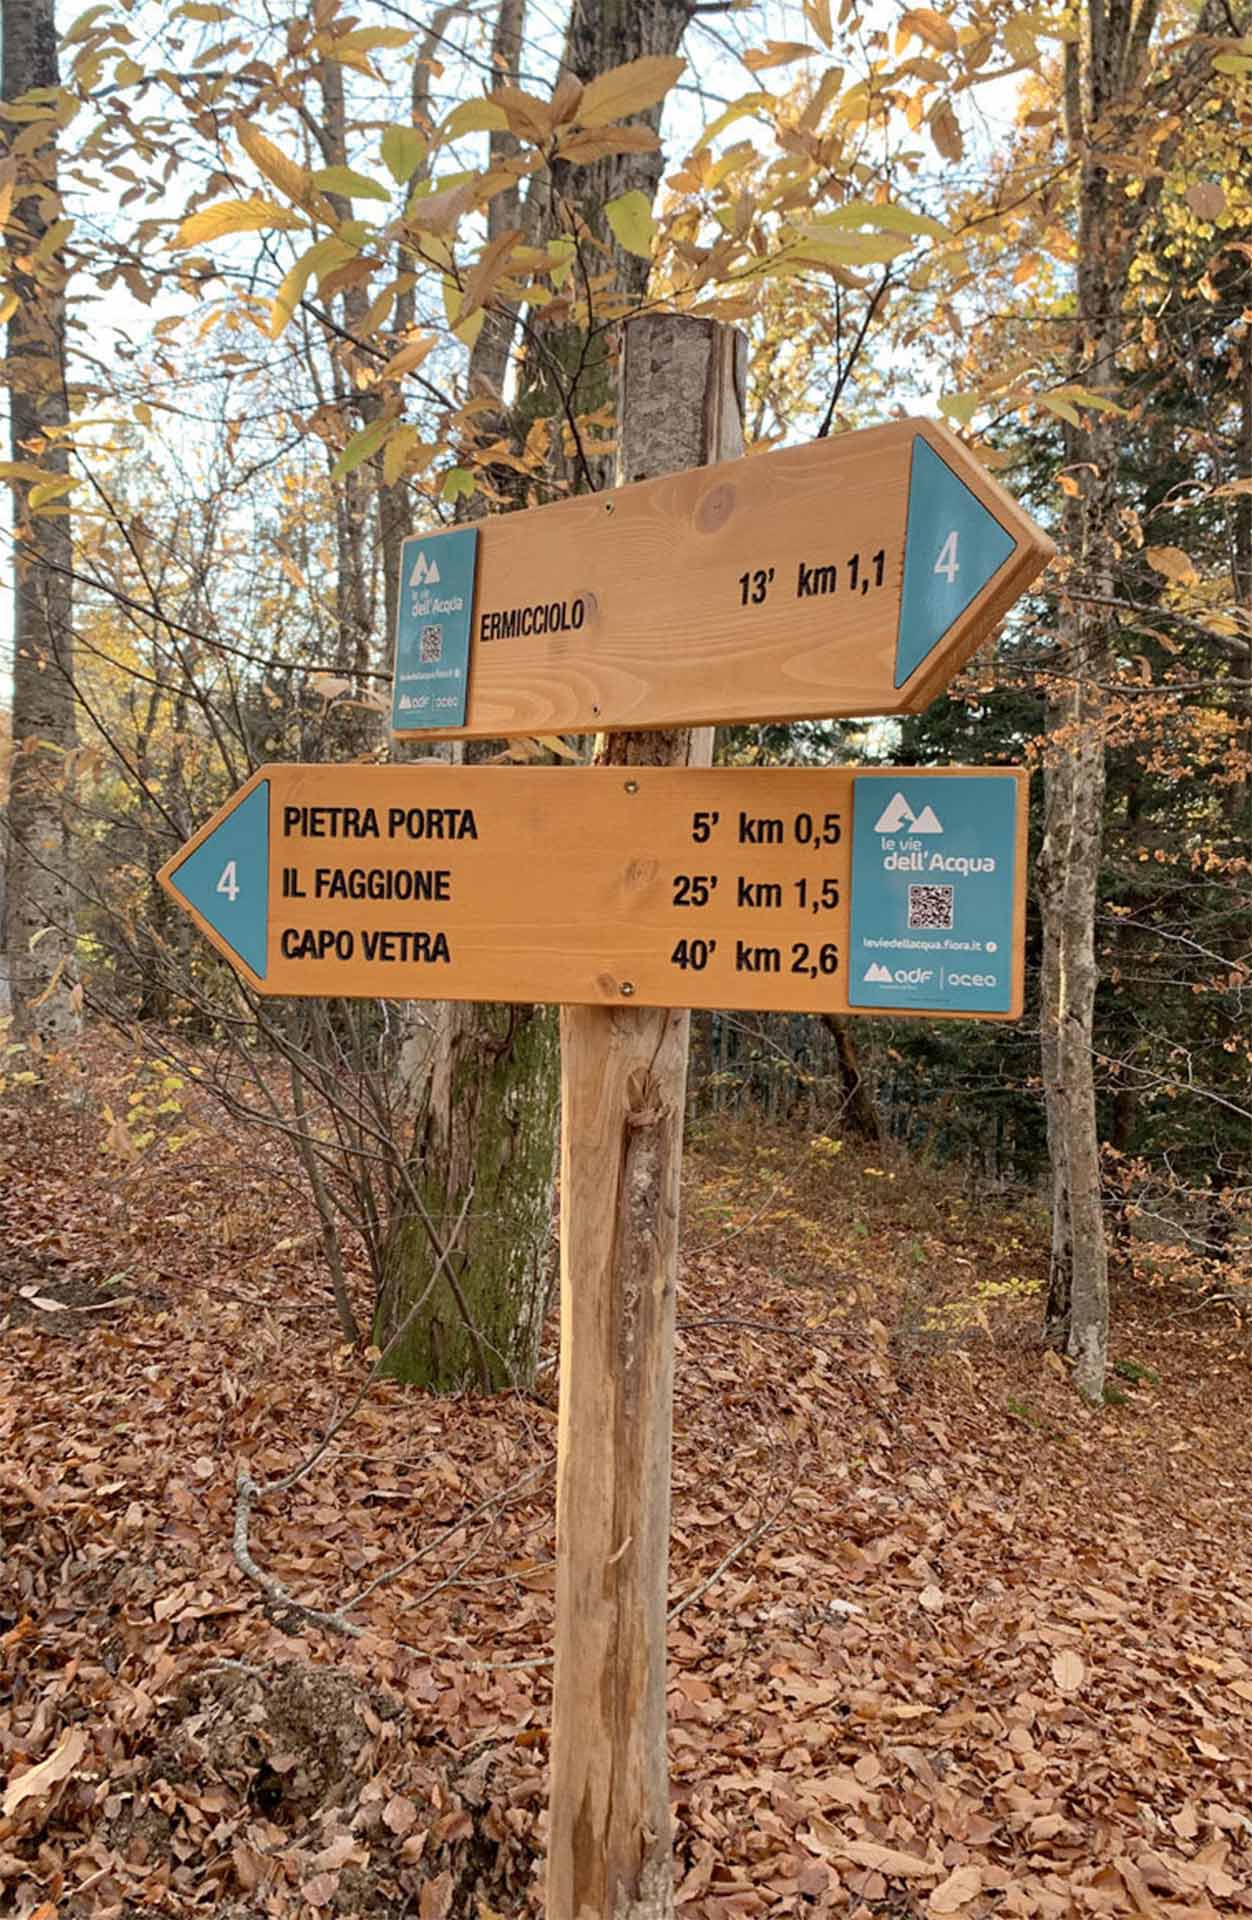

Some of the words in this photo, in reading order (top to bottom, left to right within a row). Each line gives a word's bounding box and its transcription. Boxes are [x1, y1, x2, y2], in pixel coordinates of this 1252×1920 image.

[934, 531, 960, 583] 4
[479, 598, 585, 641] ERMICCIOLO
[797, 562, 837, 598] km
[847, 549, 885, 595] 1,1
[283, 806, 380, 839] PIETRA
[387, 808, 478, 840] PORTA
[739, 812, 784, 844] km
[794, 812, 841, 850] 0,5
[881, 836, 895, 851] le
[899, 838, 922, 851] vie
[216, 861, 239, 901] 4
[883, 851, 996, 877] dell'Acqua
[282, 868, 306, 898] IL
[314, 869, 452, 901] FAGGIONE
[737, 876, 782, 907] km
[794, 878, 839, 914] 1,5
[281, 928, 354, 961] CAPO
[362, 931, 452, 963] VETRA
[736, 940, 781, 972] km
[791, 943, 839, 979] 2,6
